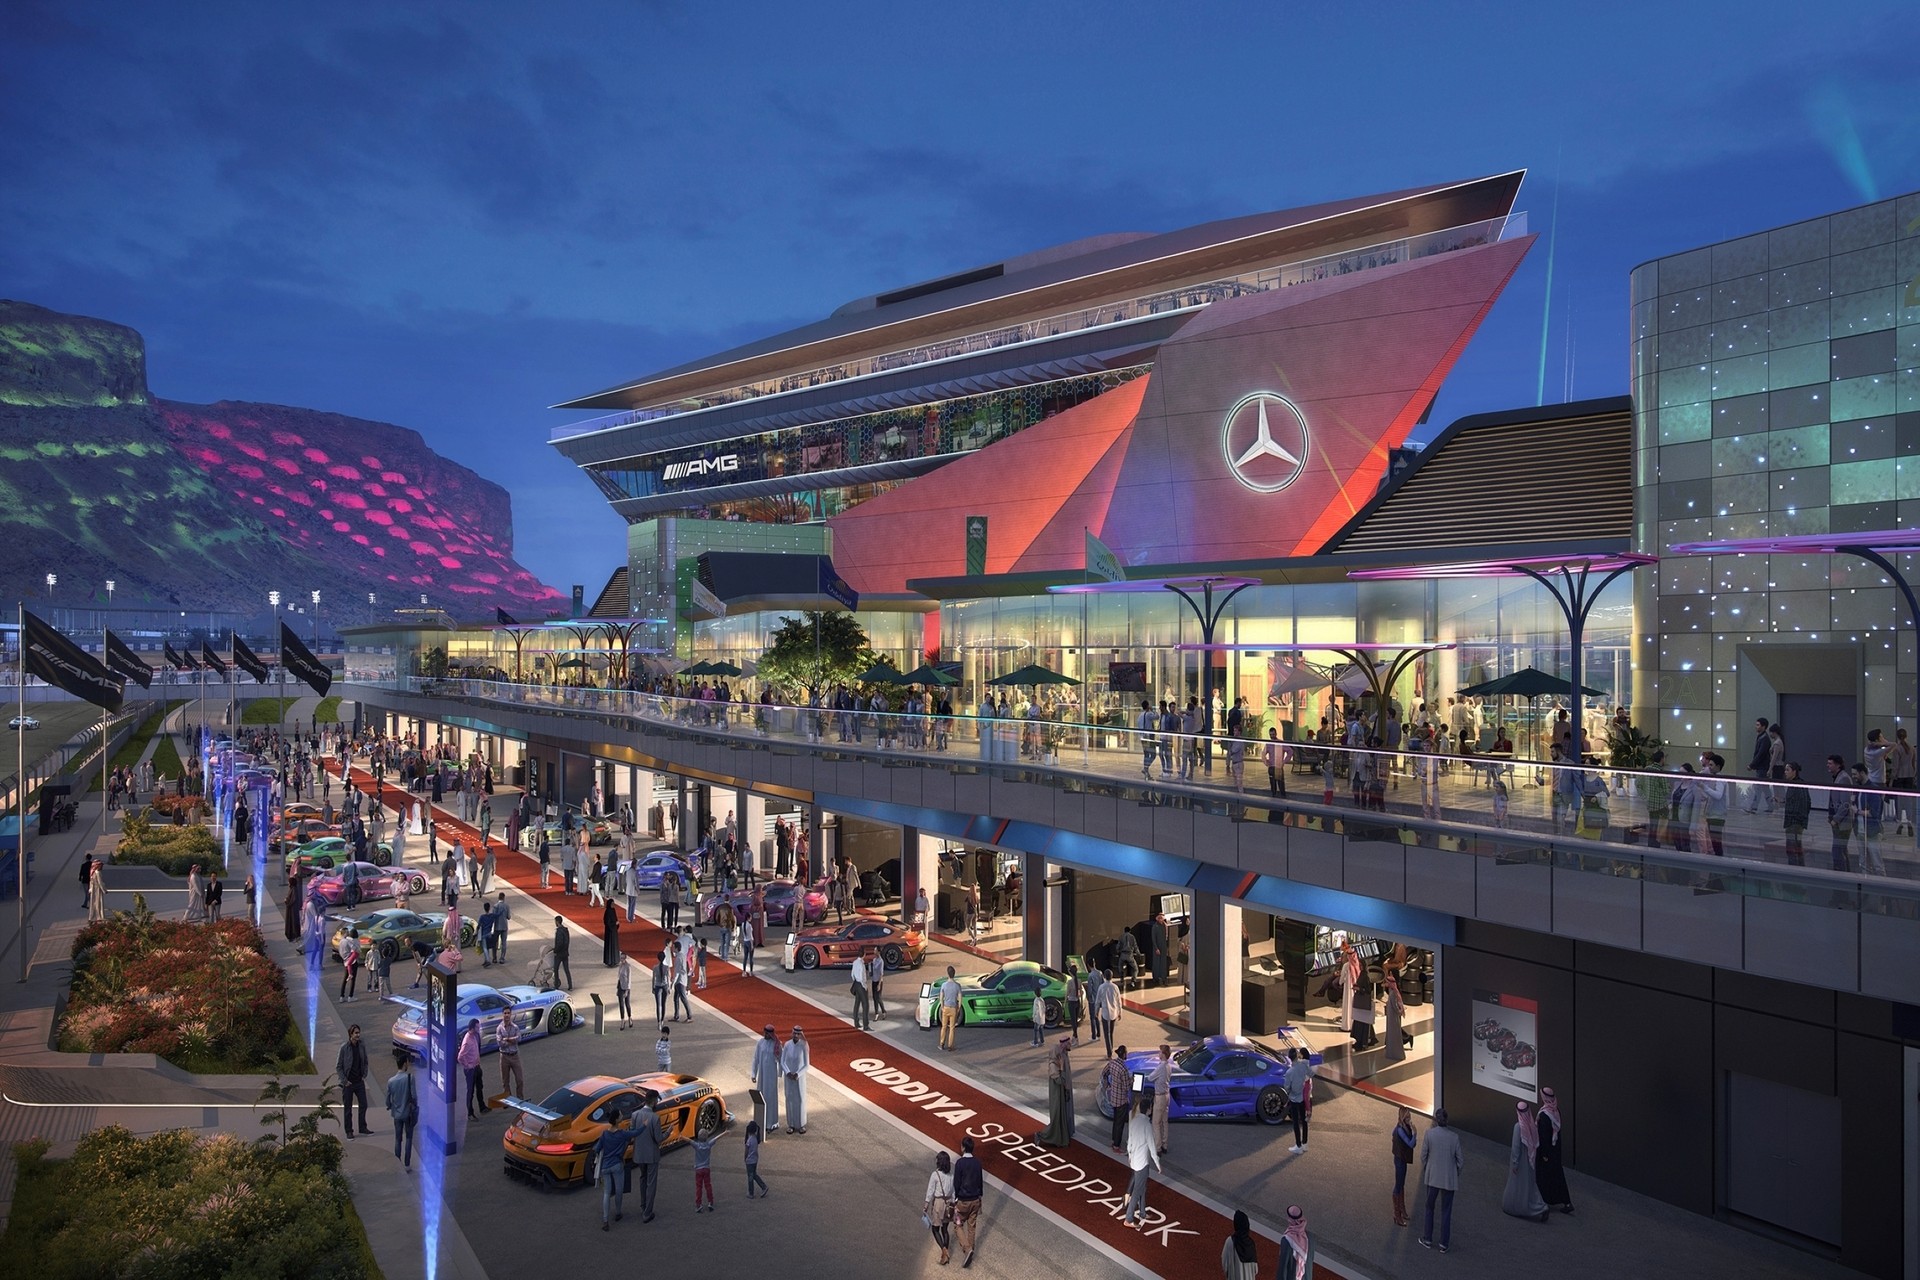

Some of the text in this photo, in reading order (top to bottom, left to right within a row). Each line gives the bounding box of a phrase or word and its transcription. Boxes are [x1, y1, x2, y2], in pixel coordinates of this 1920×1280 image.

[686, 454, 738, 477] AMG
[1660, 676, 1697, 705] 2A
[849, 1058, 1201, 1248] QIDDIYA SPEEDPARK
